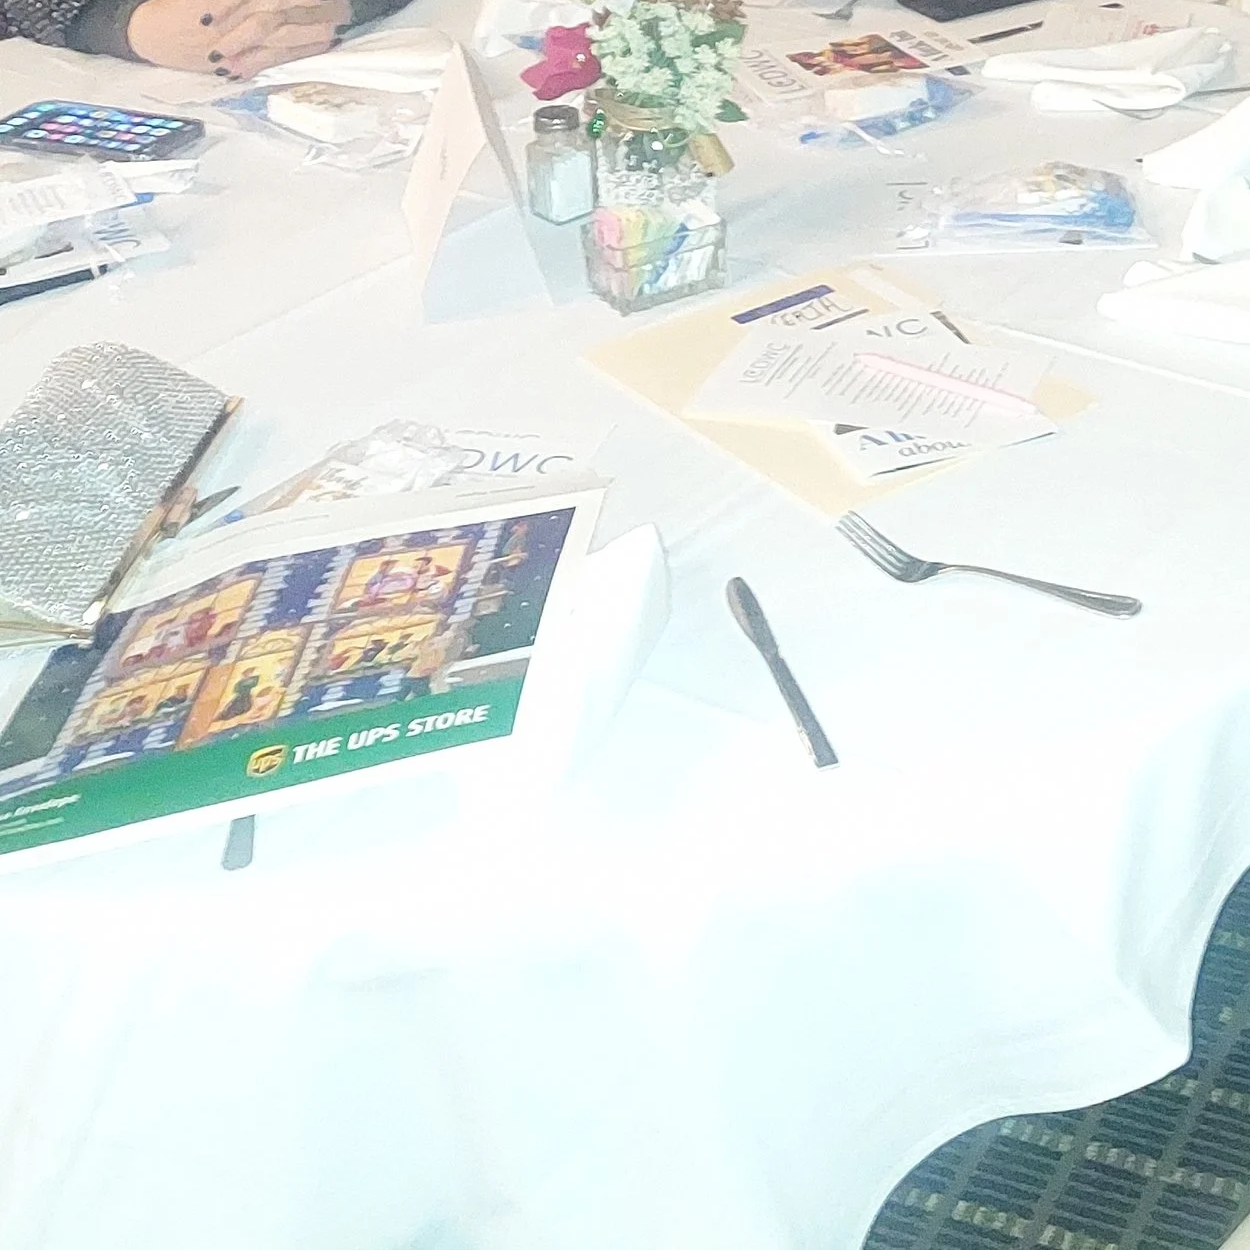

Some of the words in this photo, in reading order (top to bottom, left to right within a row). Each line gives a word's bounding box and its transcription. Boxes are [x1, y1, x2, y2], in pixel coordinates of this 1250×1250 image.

[291, 736, 343, 764] THE
[347, 723, 401, 751] UPS
[405, 704, 492, 738] STORE
